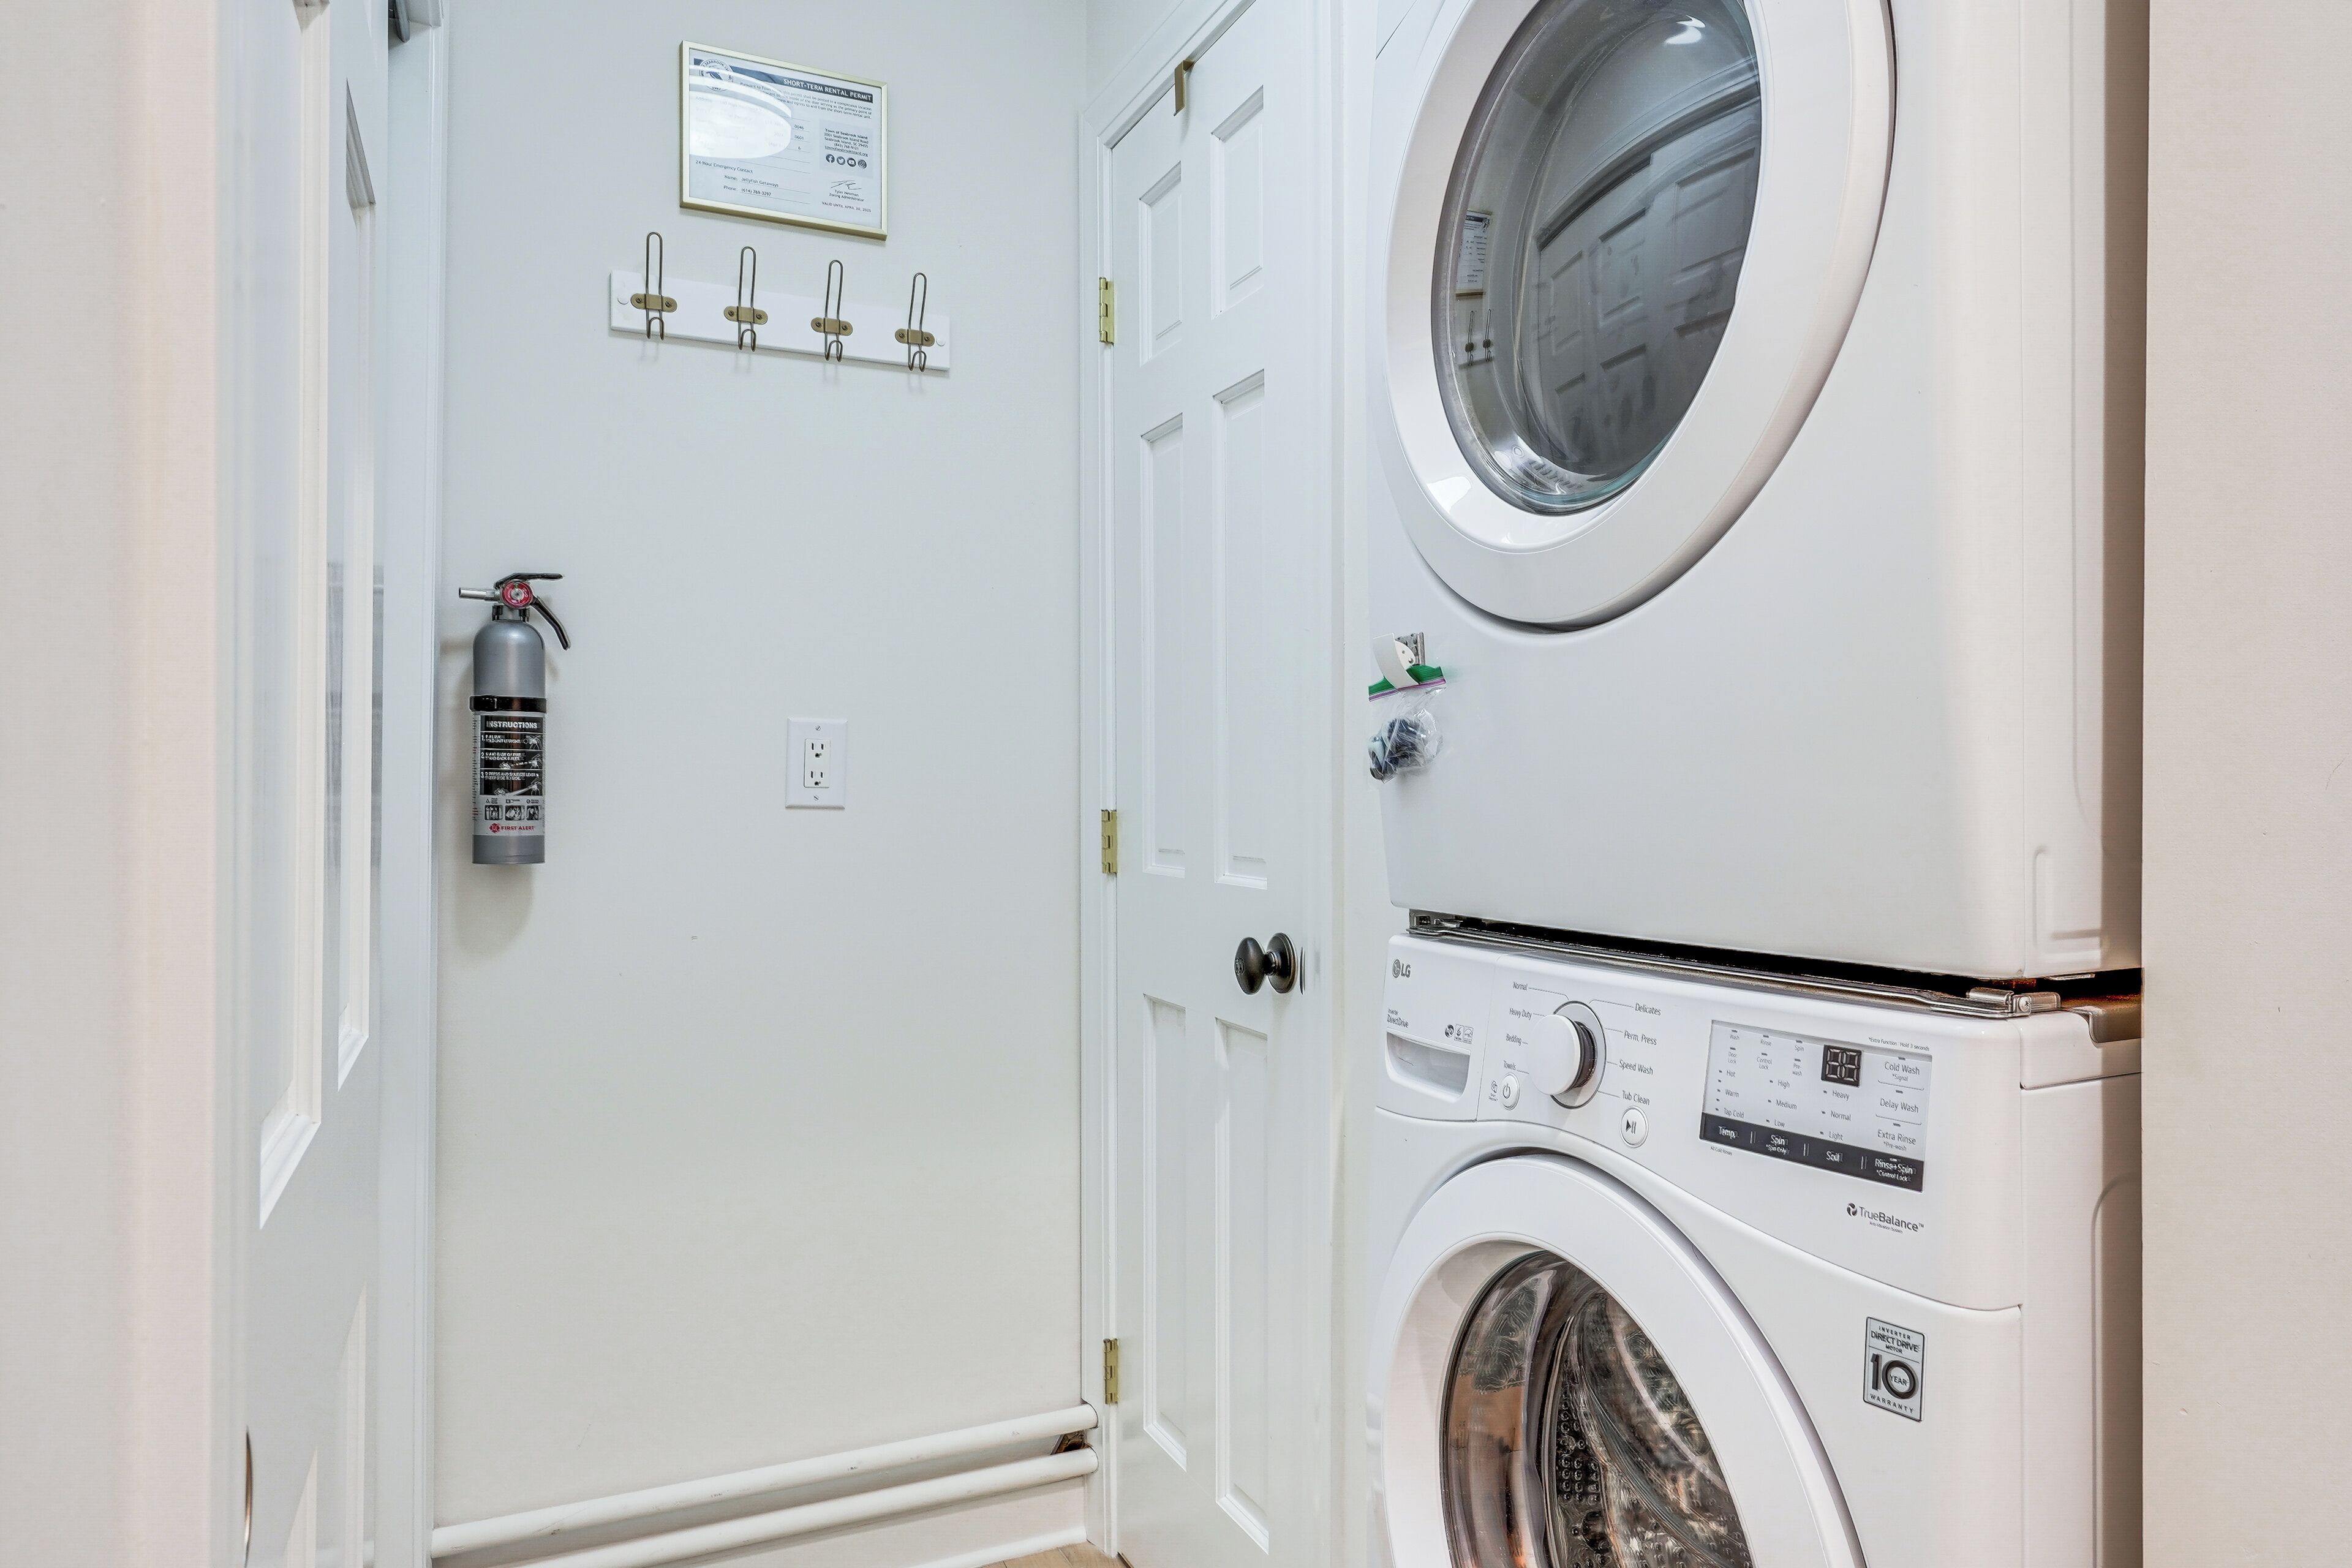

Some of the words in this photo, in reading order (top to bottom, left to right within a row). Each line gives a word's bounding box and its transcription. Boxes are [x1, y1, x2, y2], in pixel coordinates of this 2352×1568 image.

[783, 78, 823, 92] SHORT-TERM
[825, 87, 848, 97] RENTAL
[850, 91, 872, 101] PERMIT
[1401, 963, 1411, 978] LG
[1513, 982, 1528, 990] Normal
[1509, 1008, 1521, 1018] Heavy
[1522, 1009, 1532, 1020] Duty
[1635, 1003, 1661, 1016] Delicates
[1387, 1014, 1409, 1028] DirectDrive
[1506, 1033, 1522, 1046] Bedding
[1624, 1030, 1639, 1042] Perm.
[1641, 1034, 1657, 1046] Press
[1503, 1060, 1517, 1071] Towels
[1619, 1059, 1637, 1071] Speed
[1638, 1064, 1653, 1076] Wash
[1885, 1061, 1899, 1072] Cold
[1902, 1064, 1920, 1075] Wash
[1778, 1079, 1790, 1089] High
[1622, 1090, 1632, 1101] Tub
[1633, 1093, 1650, 1105] Clean
[1725, 1089, 1740, 1098] Warm
[1832, 1090, 1850, 1101] Heavy
[1776, 1099, 1797, 1110] Medium
[1880, 1098, 1899, 1111] Delay
[1901, 1102, 1918, 1114] Wash
[1724, 1107, 1732, 1117] Tap
[1733, 1110, 1744, 1118] Cold
[1830, 1110, 1852, 1121] Normal
[1718, 1125, 1737, 1140] Temp.
[1829, 1131, 1844, 1142] Light
[1877, 1129, 1896, 1140] Extra
[1898, 1133, 1917, 1145] Rinse
[1770, 1135, 1787, 1146] Spin
[1777, 1146, 1788, 1155] Only
[1875, 1158, 1915, 1175] Rinse+Spin
[1896, 1174, 1910, 1182] Lock
[1879, 1325, 1911, 1340] INVERTER
[1871, 1330, 1895, 1346] DIRECT
[1896, 1338, 1919, 1352] DRIVE
[1885, 1344, 1903, 1354] MOTOR
[1870, 1353, 1919, 1400] 10
[1890, 1373, 1907, 1386] YEAR
[1870, 1393, 1913, 1414] WARRANTY
